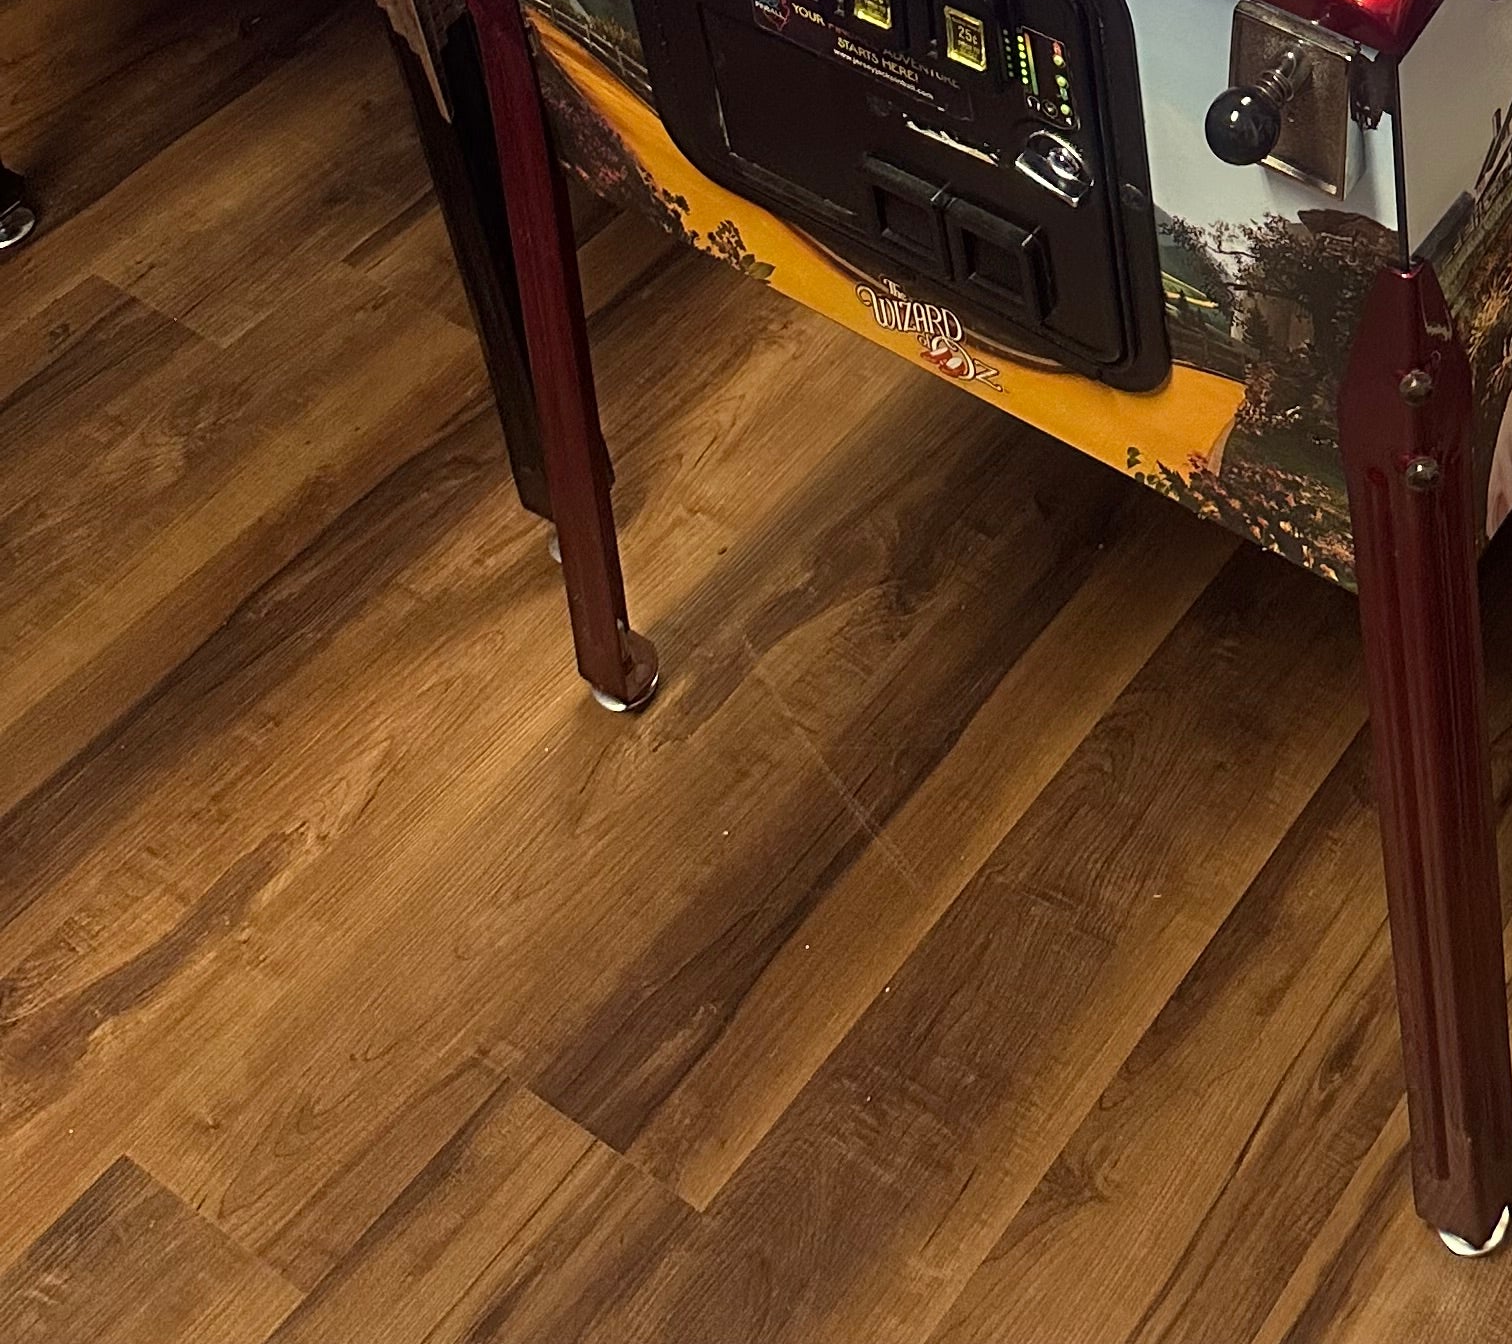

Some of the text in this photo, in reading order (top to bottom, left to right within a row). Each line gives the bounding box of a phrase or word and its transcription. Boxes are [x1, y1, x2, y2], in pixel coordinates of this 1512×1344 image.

[792, 2, 826, 27] YOUR
[837, 36, 880, 64] STARTS
[883, 278, 908, 301] The
[856, 284, 963, 343] WIZARD
[930, 335, 1003, 392] Oz
